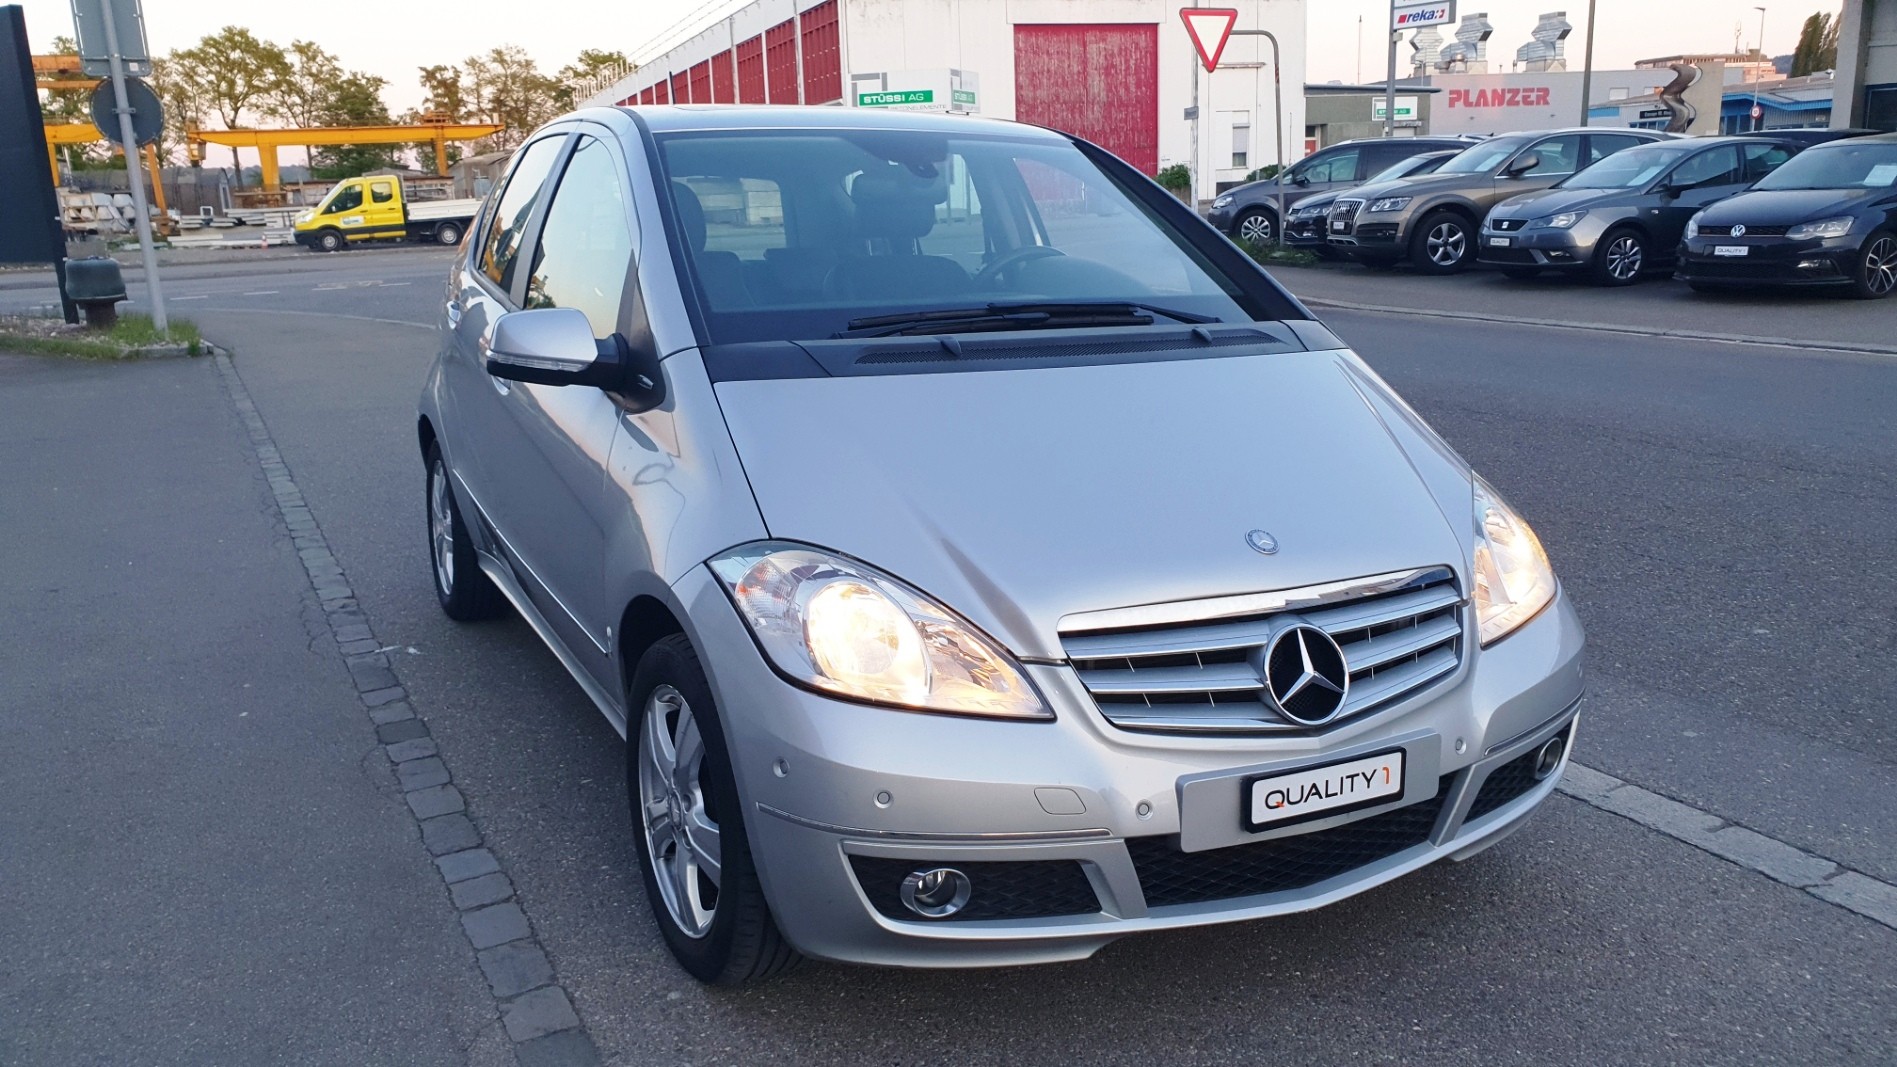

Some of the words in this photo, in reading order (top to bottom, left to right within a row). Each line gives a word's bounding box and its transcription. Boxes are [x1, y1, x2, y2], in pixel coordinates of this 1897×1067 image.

[863, 93, 905, 104] STÜSSI
[908, 93, 924, 101] AG
[1448, 87, 1550, 108] PLANZER
[1264, 769, 1377, 810] QUALITY
[1382, 766, 1391, 785] 1
